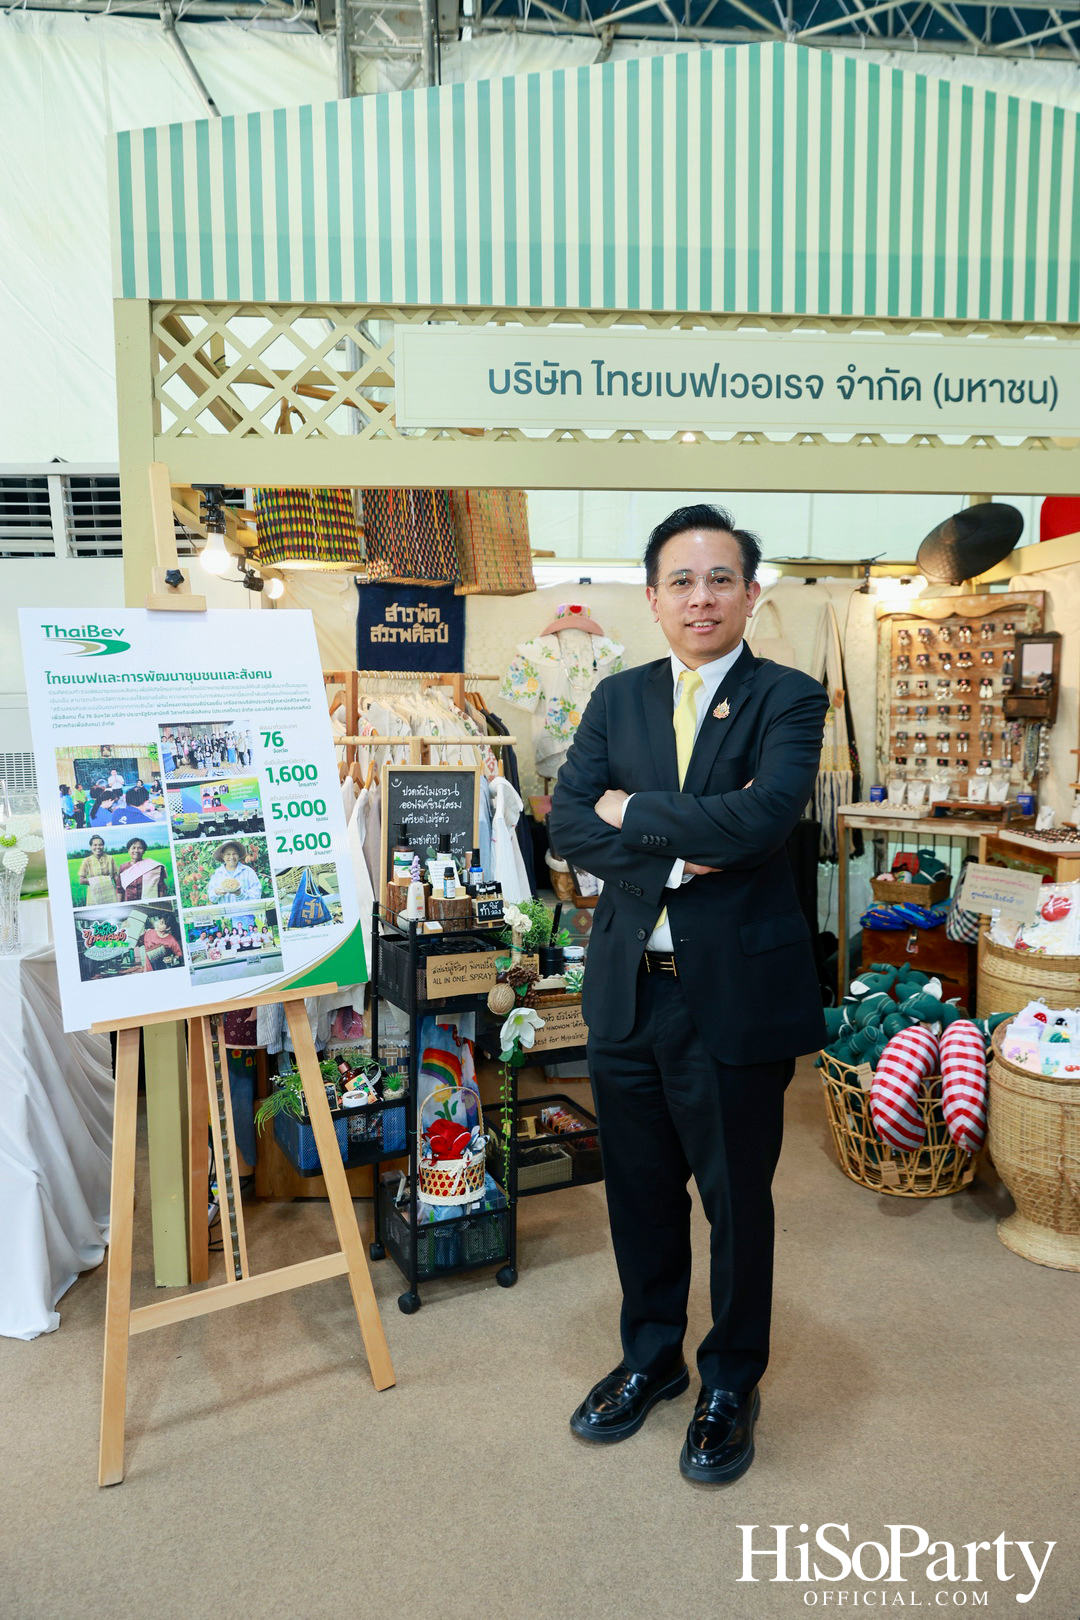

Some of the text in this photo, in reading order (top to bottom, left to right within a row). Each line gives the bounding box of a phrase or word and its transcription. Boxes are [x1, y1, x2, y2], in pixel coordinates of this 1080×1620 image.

[487, 358, 1059, 411] บริษัท ไทยเบฟเวอเรจ จำกัด (มหาชน)
[384, 602, 441, 624] สารพัด
[41, 624, 125, 638] ThaiBev
[370, 623, 449, 645] สรรพศิลป์
[44, 669, 272, 685] ไทยเบฟและการพัฒนาชุมชนและสังคม
[260, 730, 284, 748] 76
[265, 764, 318, 786] 1,600
[271, 799, 327, 822] 5,000
[275, 831, 332, 855] 2,600
[432, 972, 494, 985] ALL IN ONE SPRAY
[560, 1033, 588, 1043] Migraine
